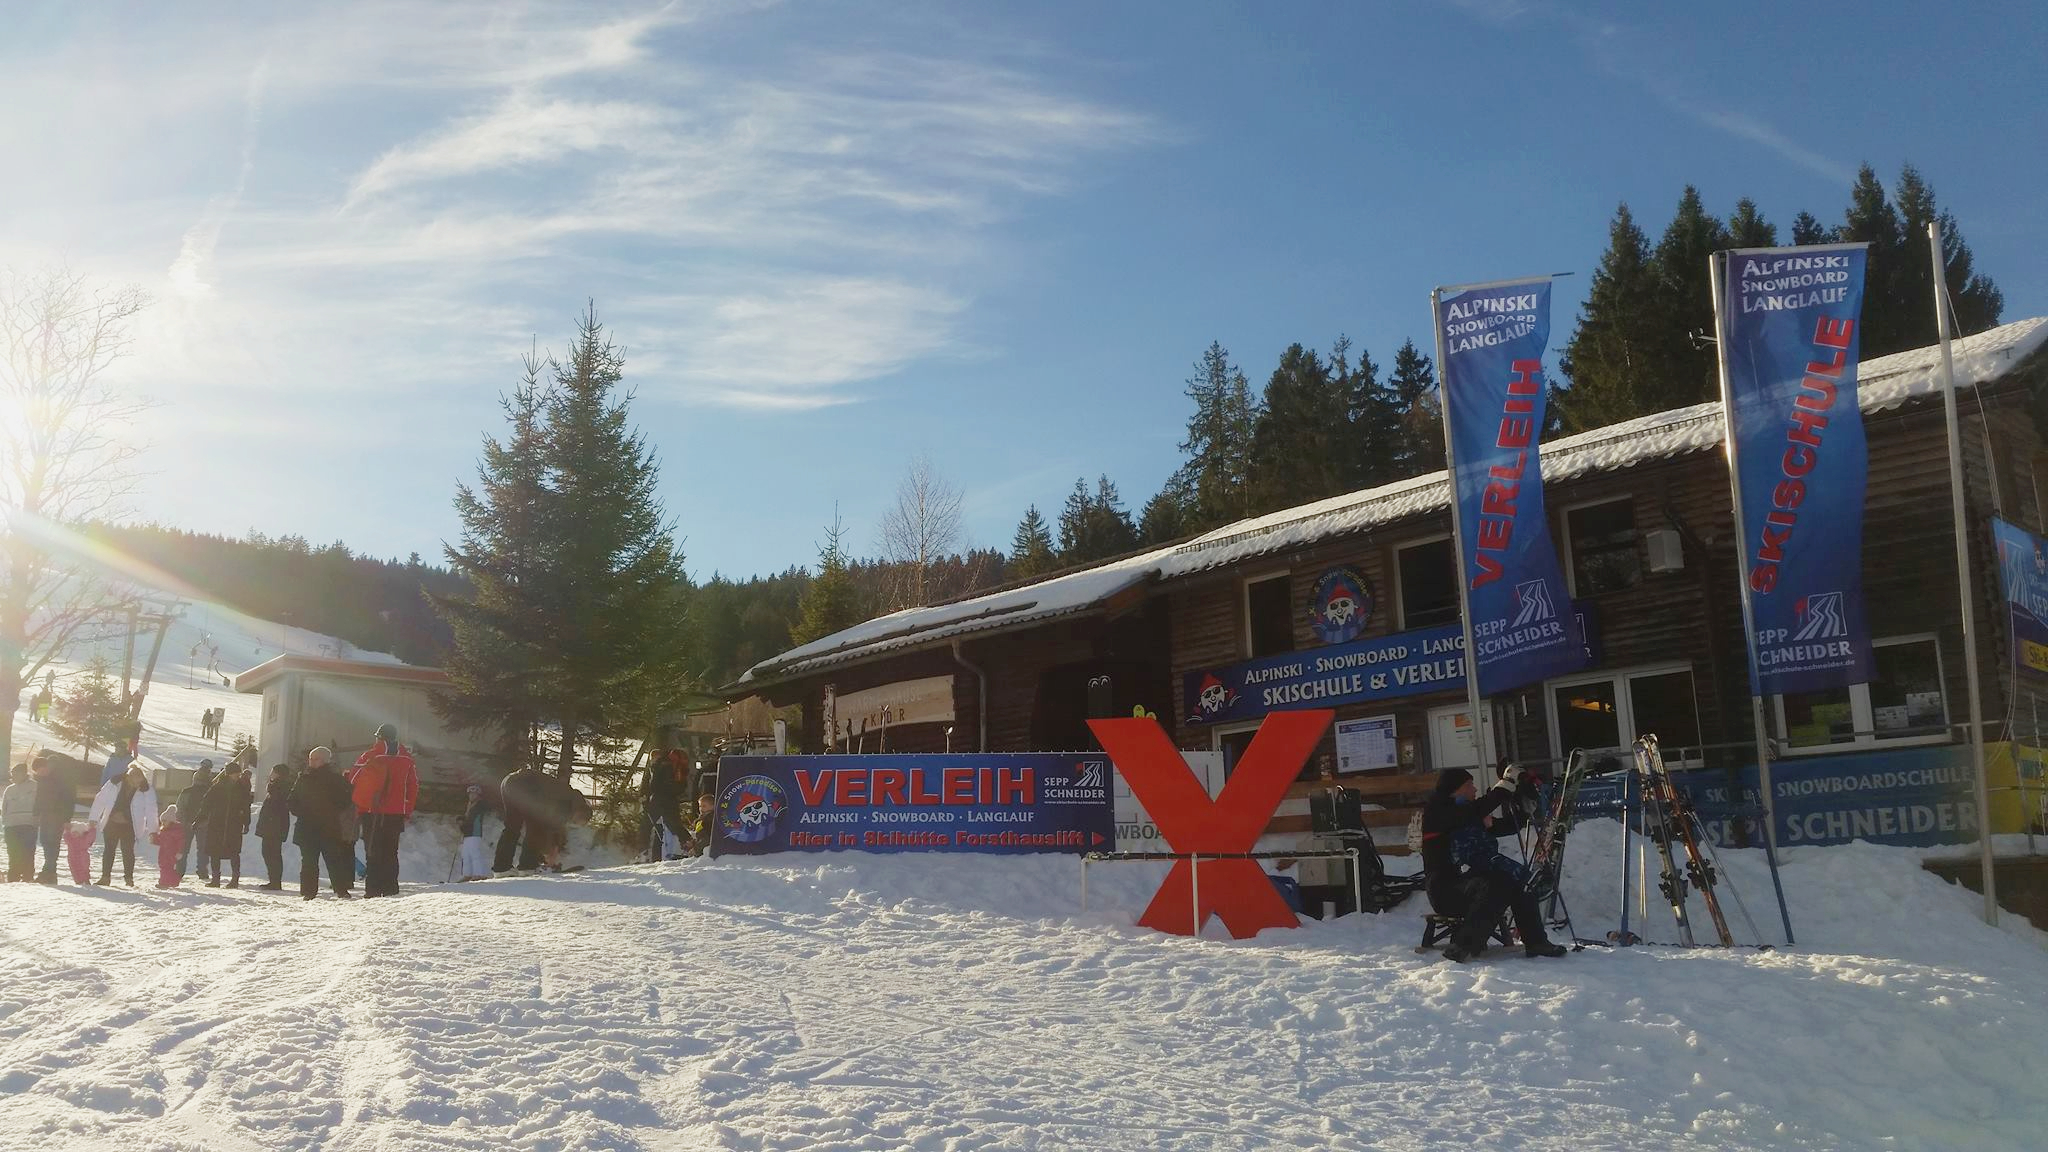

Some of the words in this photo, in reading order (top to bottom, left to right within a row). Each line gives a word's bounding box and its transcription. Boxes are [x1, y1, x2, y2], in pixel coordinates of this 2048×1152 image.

[1742, 256, 1849, 278] ALPINSKI
[1742, 271, 1849, 294] SNOWBOARD
[1446, 293, 1537, 322] ALPINSKI
[1743, 287, 1848, 314] LANGLAUF
[1448, 322, 1536, 355] LANGLAUF
[1751, 315, 1854, 594] SKISCHULE
[1471, 359, 1542, 591] VERLEIH
[1474, 619, 1507, 638] SEPP
[1477, 621, 1564, 657] SCHNEIDER
[1245, 662, 1303, 685] ALPINSKI
[1316, 646, 1408, 673] SNOWBOARD
[1759, 640, 1853, 666] CHNEIDER
[1263, 674, 1363, 706] SKISCHULE
[1370, 672, 1388, 690] &
[794, 767, 1035, 806] VERLEIH
[1044, 777, 1069, 786] SEPP
[1044, 789, 1105, 798] SCHNEIDER
[1777, 767, 1976, 797] SNOWBOARDSCHULE
[800, 811, 858, 823] ALPINSKI
[872, 811, 955, 823] SNOWBOARD
[968, 810, 1034, 822] LANGLAUF
[1787, 802, 1979, 840] SCHNEIDER
[790, 831, 832, 847] Hier
[839, 831, 857, 847] in
[864, 830, 949, 847] Skihütte
[956, 830, 1085, 847] Forsthauslift
